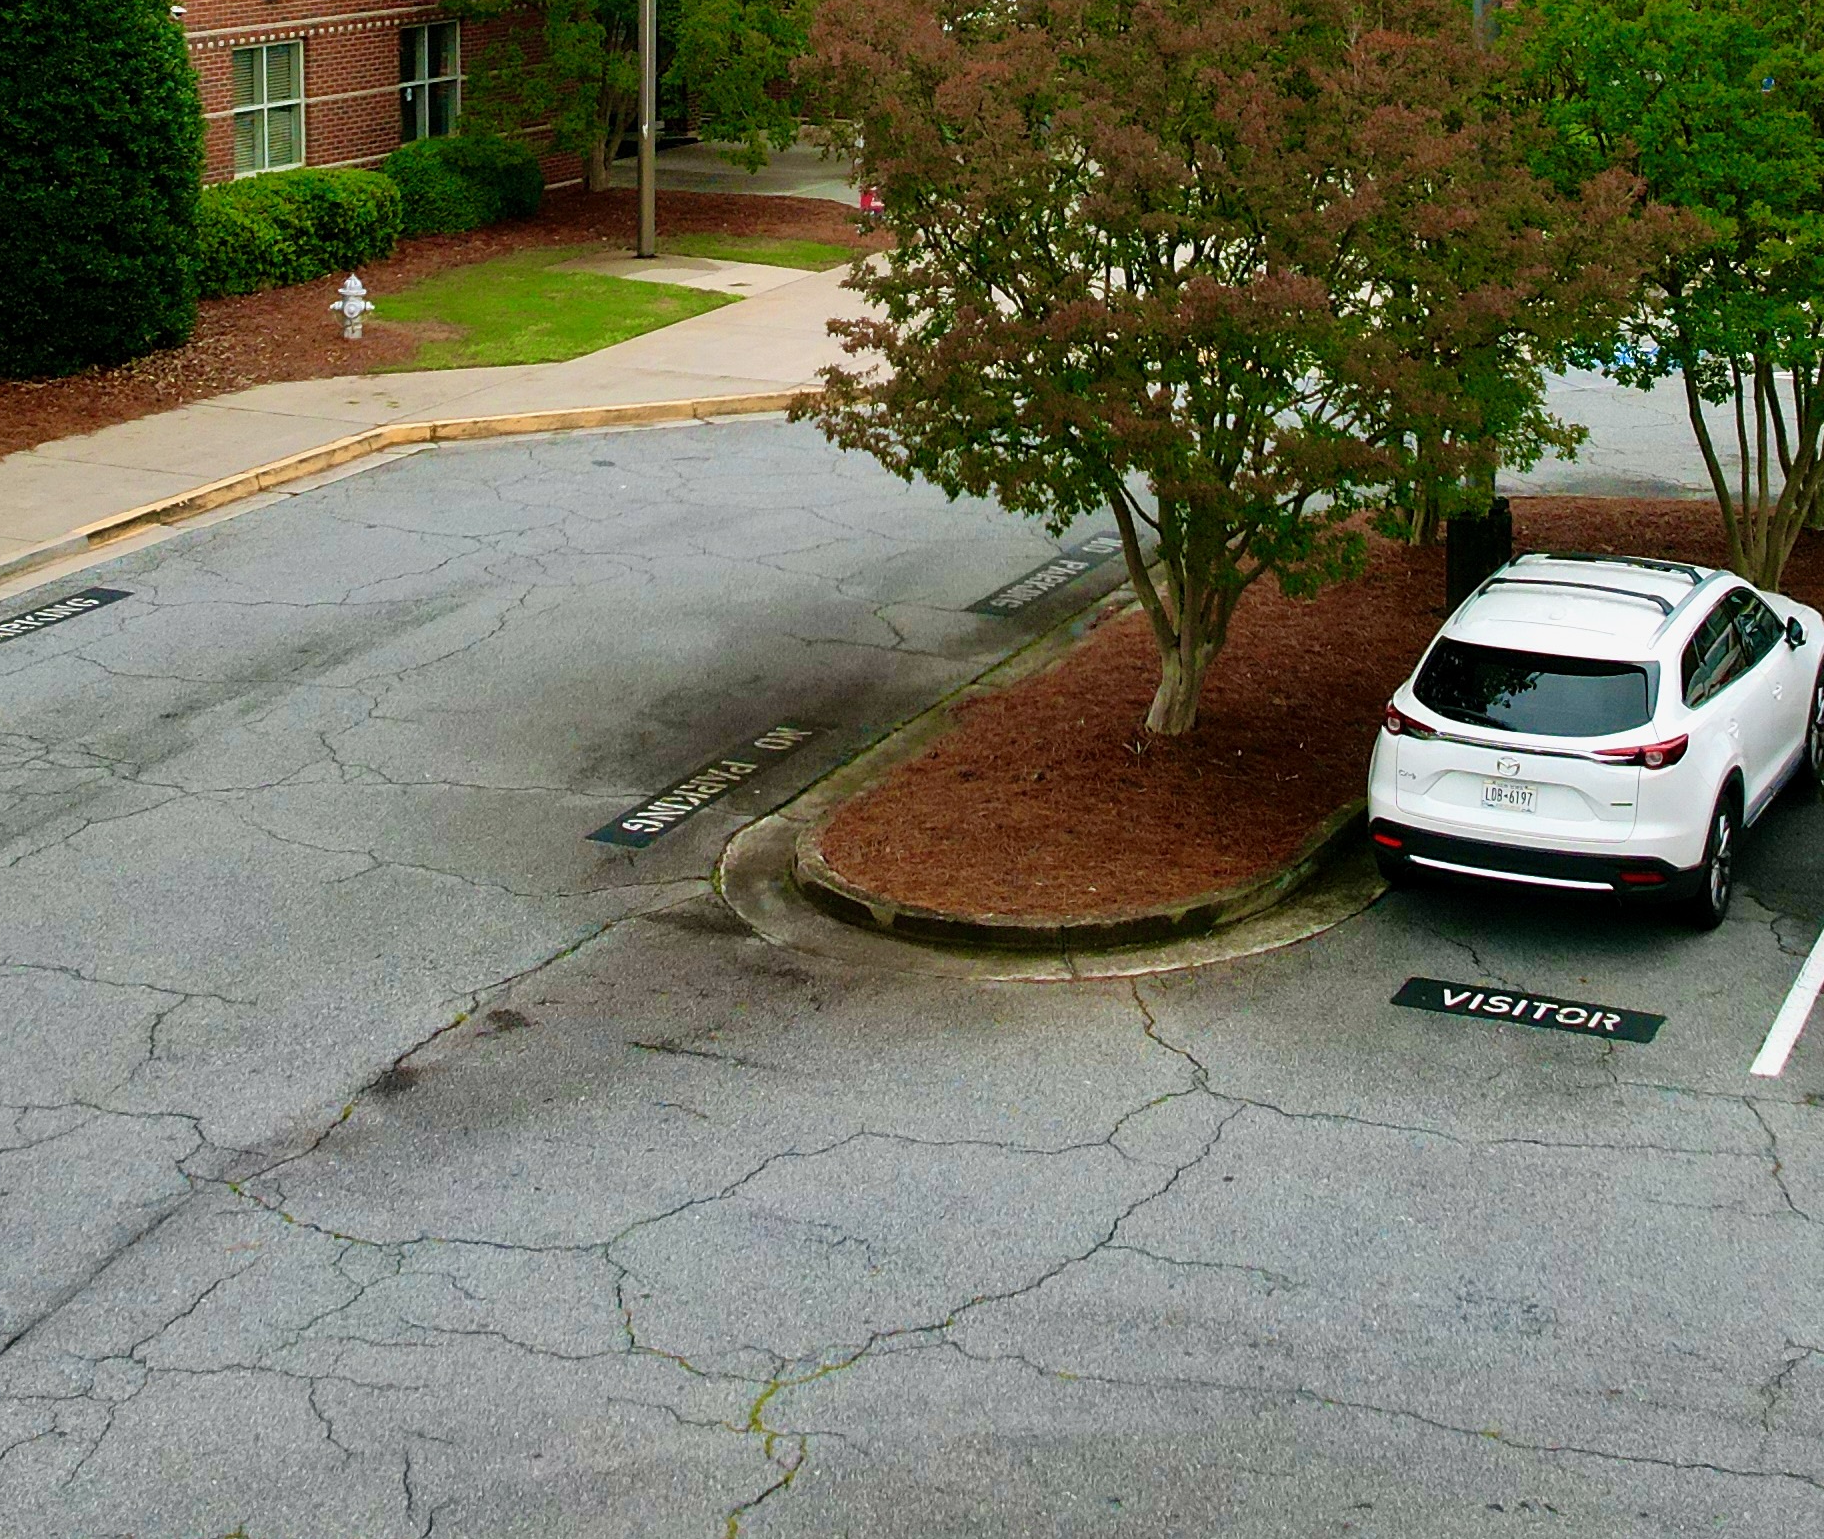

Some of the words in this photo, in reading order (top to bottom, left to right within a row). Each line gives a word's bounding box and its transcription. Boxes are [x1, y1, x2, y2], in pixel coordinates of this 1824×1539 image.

[754, 727, 813, 750] NO
[622, 760, 758, 833] PARKING
[1442, 988, 1622, 1032] VISITOR
